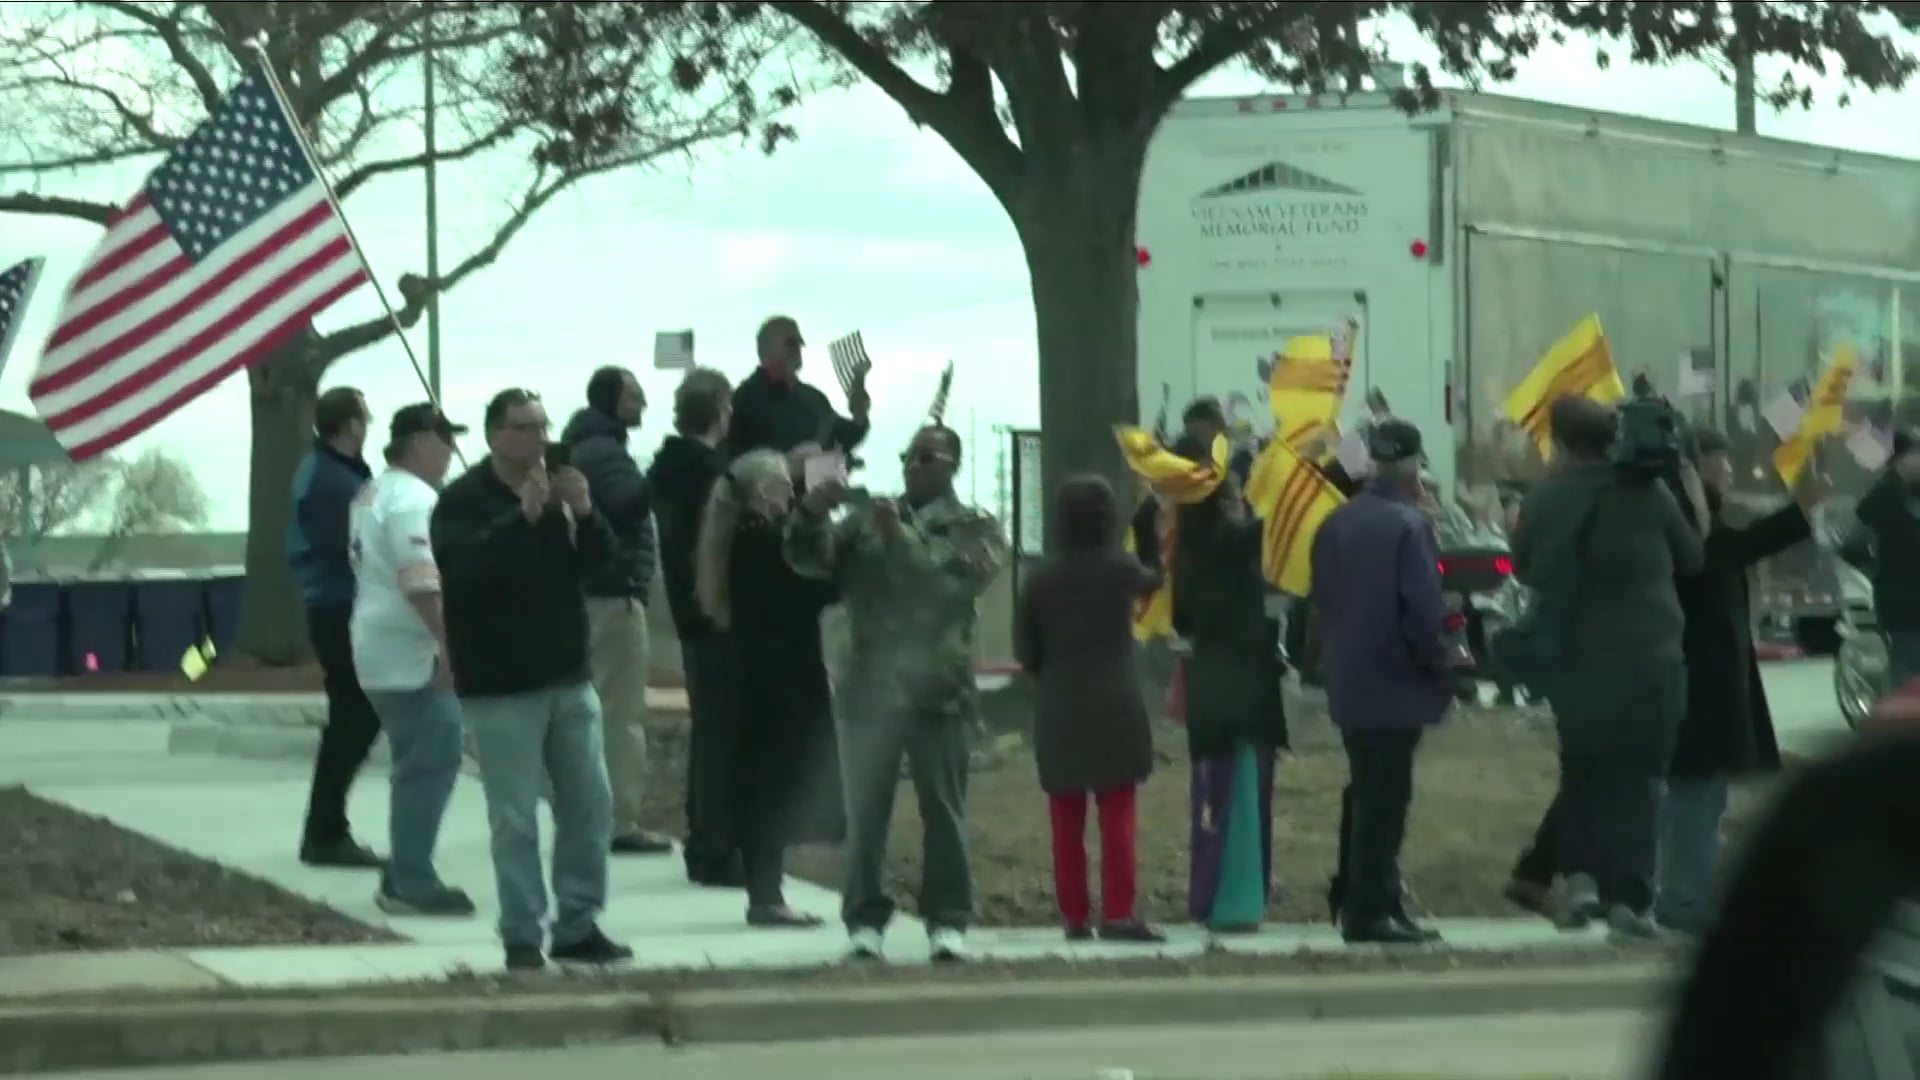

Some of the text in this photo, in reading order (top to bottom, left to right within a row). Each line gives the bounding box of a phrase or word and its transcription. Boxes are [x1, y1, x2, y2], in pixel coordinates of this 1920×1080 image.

[1279, 202, 1369, 219] VETERANS
[1200, 218, 1360, 238] MEMORIAL FUND
